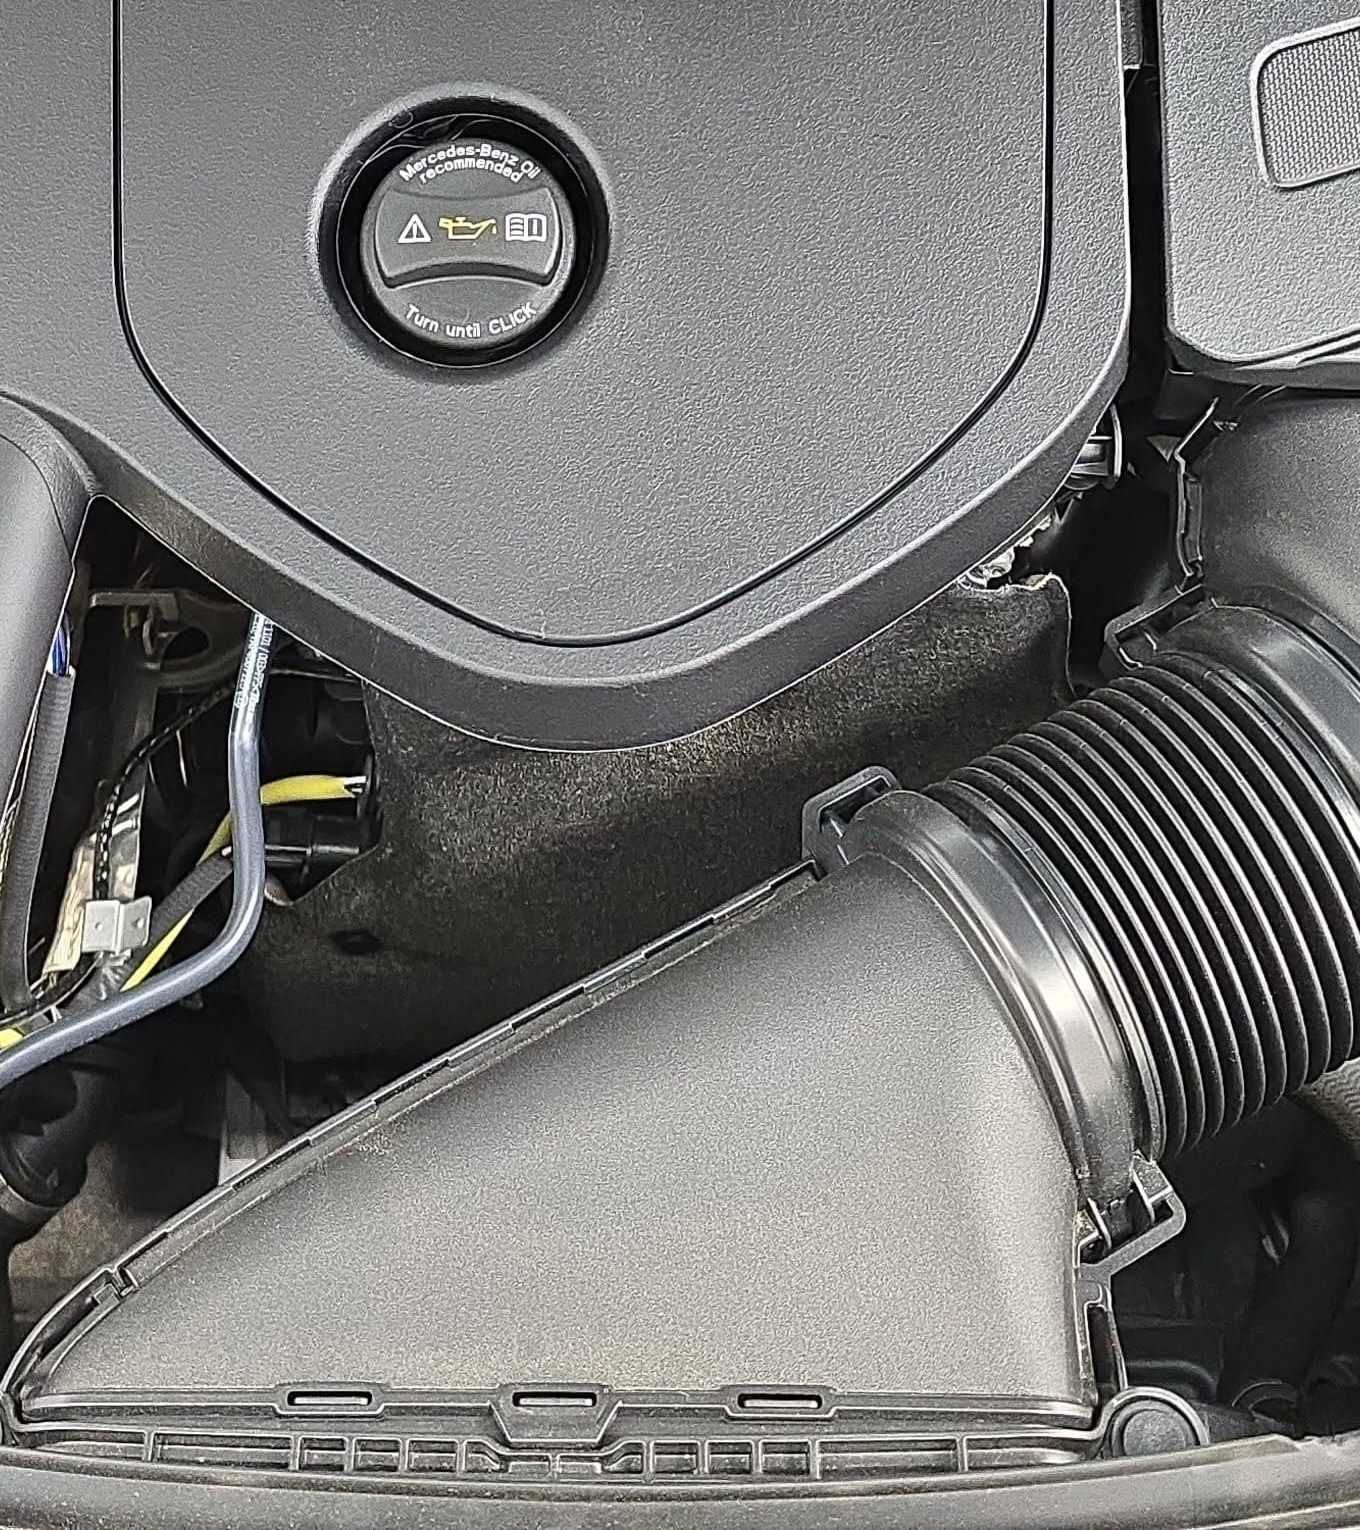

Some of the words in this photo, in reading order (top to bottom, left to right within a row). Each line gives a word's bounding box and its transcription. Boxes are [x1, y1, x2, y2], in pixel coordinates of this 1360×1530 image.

[399, 143, 520, 183] Mercedes-Benz
[520, 159, 542, 180] Oil
[419, 156, 524, 185] recommended
[404, 303, 439, 334] Turn
[446, 322, 481, 338] until
[488, 300, 538, 336] CLICK
